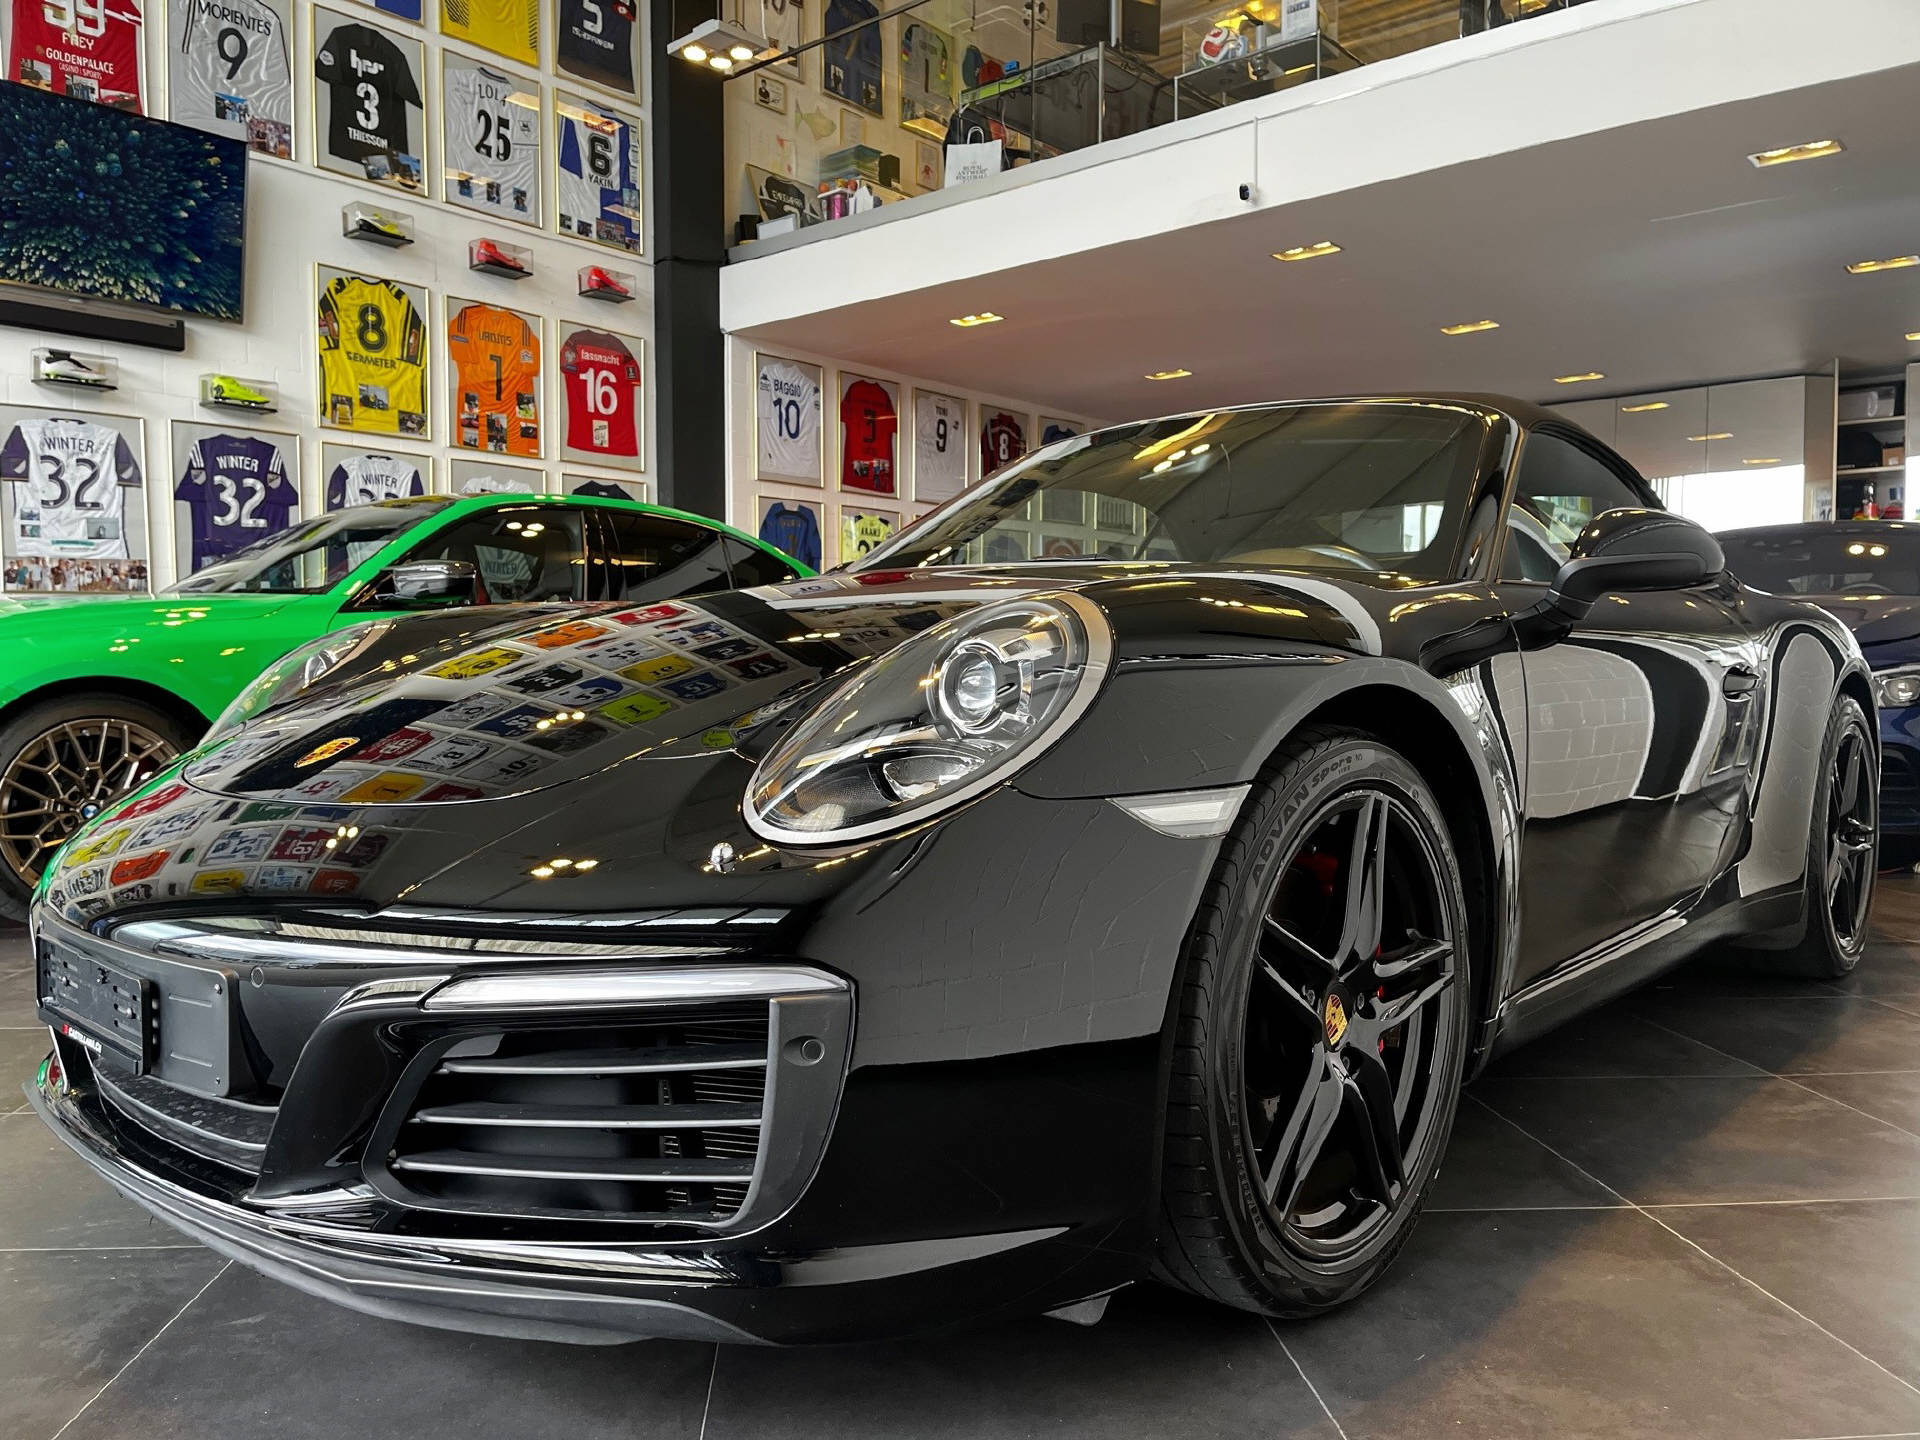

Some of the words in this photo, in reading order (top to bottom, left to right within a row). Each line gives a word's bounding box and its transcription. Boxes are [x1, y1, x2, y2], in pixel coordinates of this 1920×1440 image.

[198, 0, 272, 37] MORIENTES
[45, 47, 114, 75] GOLDENPALACE
[217, 27, 248, 80] 9
[355, 81, 380, 131] 3
[474, 108, 511, 162] 25
[588, 132, 612, 179] 6
[587, 173, 614, 189] YAKIN
[357, 303, 388, 353] 8
[488, 353, 503, 402] 1
[579, 367, 619, 416] 16
[773, 378, 802, 398] BAGGIO
[772, 397, 801, 440] 10
[936, 418, 948, 453] 9
[45, 436, 96, 454] WINTER
[215, 455, 260, 473] WINTER
[999, 431, 1010, 461] 8
[39, 454, 106, 511] 32
[213, 474, 269, 528] 32
[361, 474, 399, 489] WINTER
[1252, 783, 1310, 889] ADVAN
